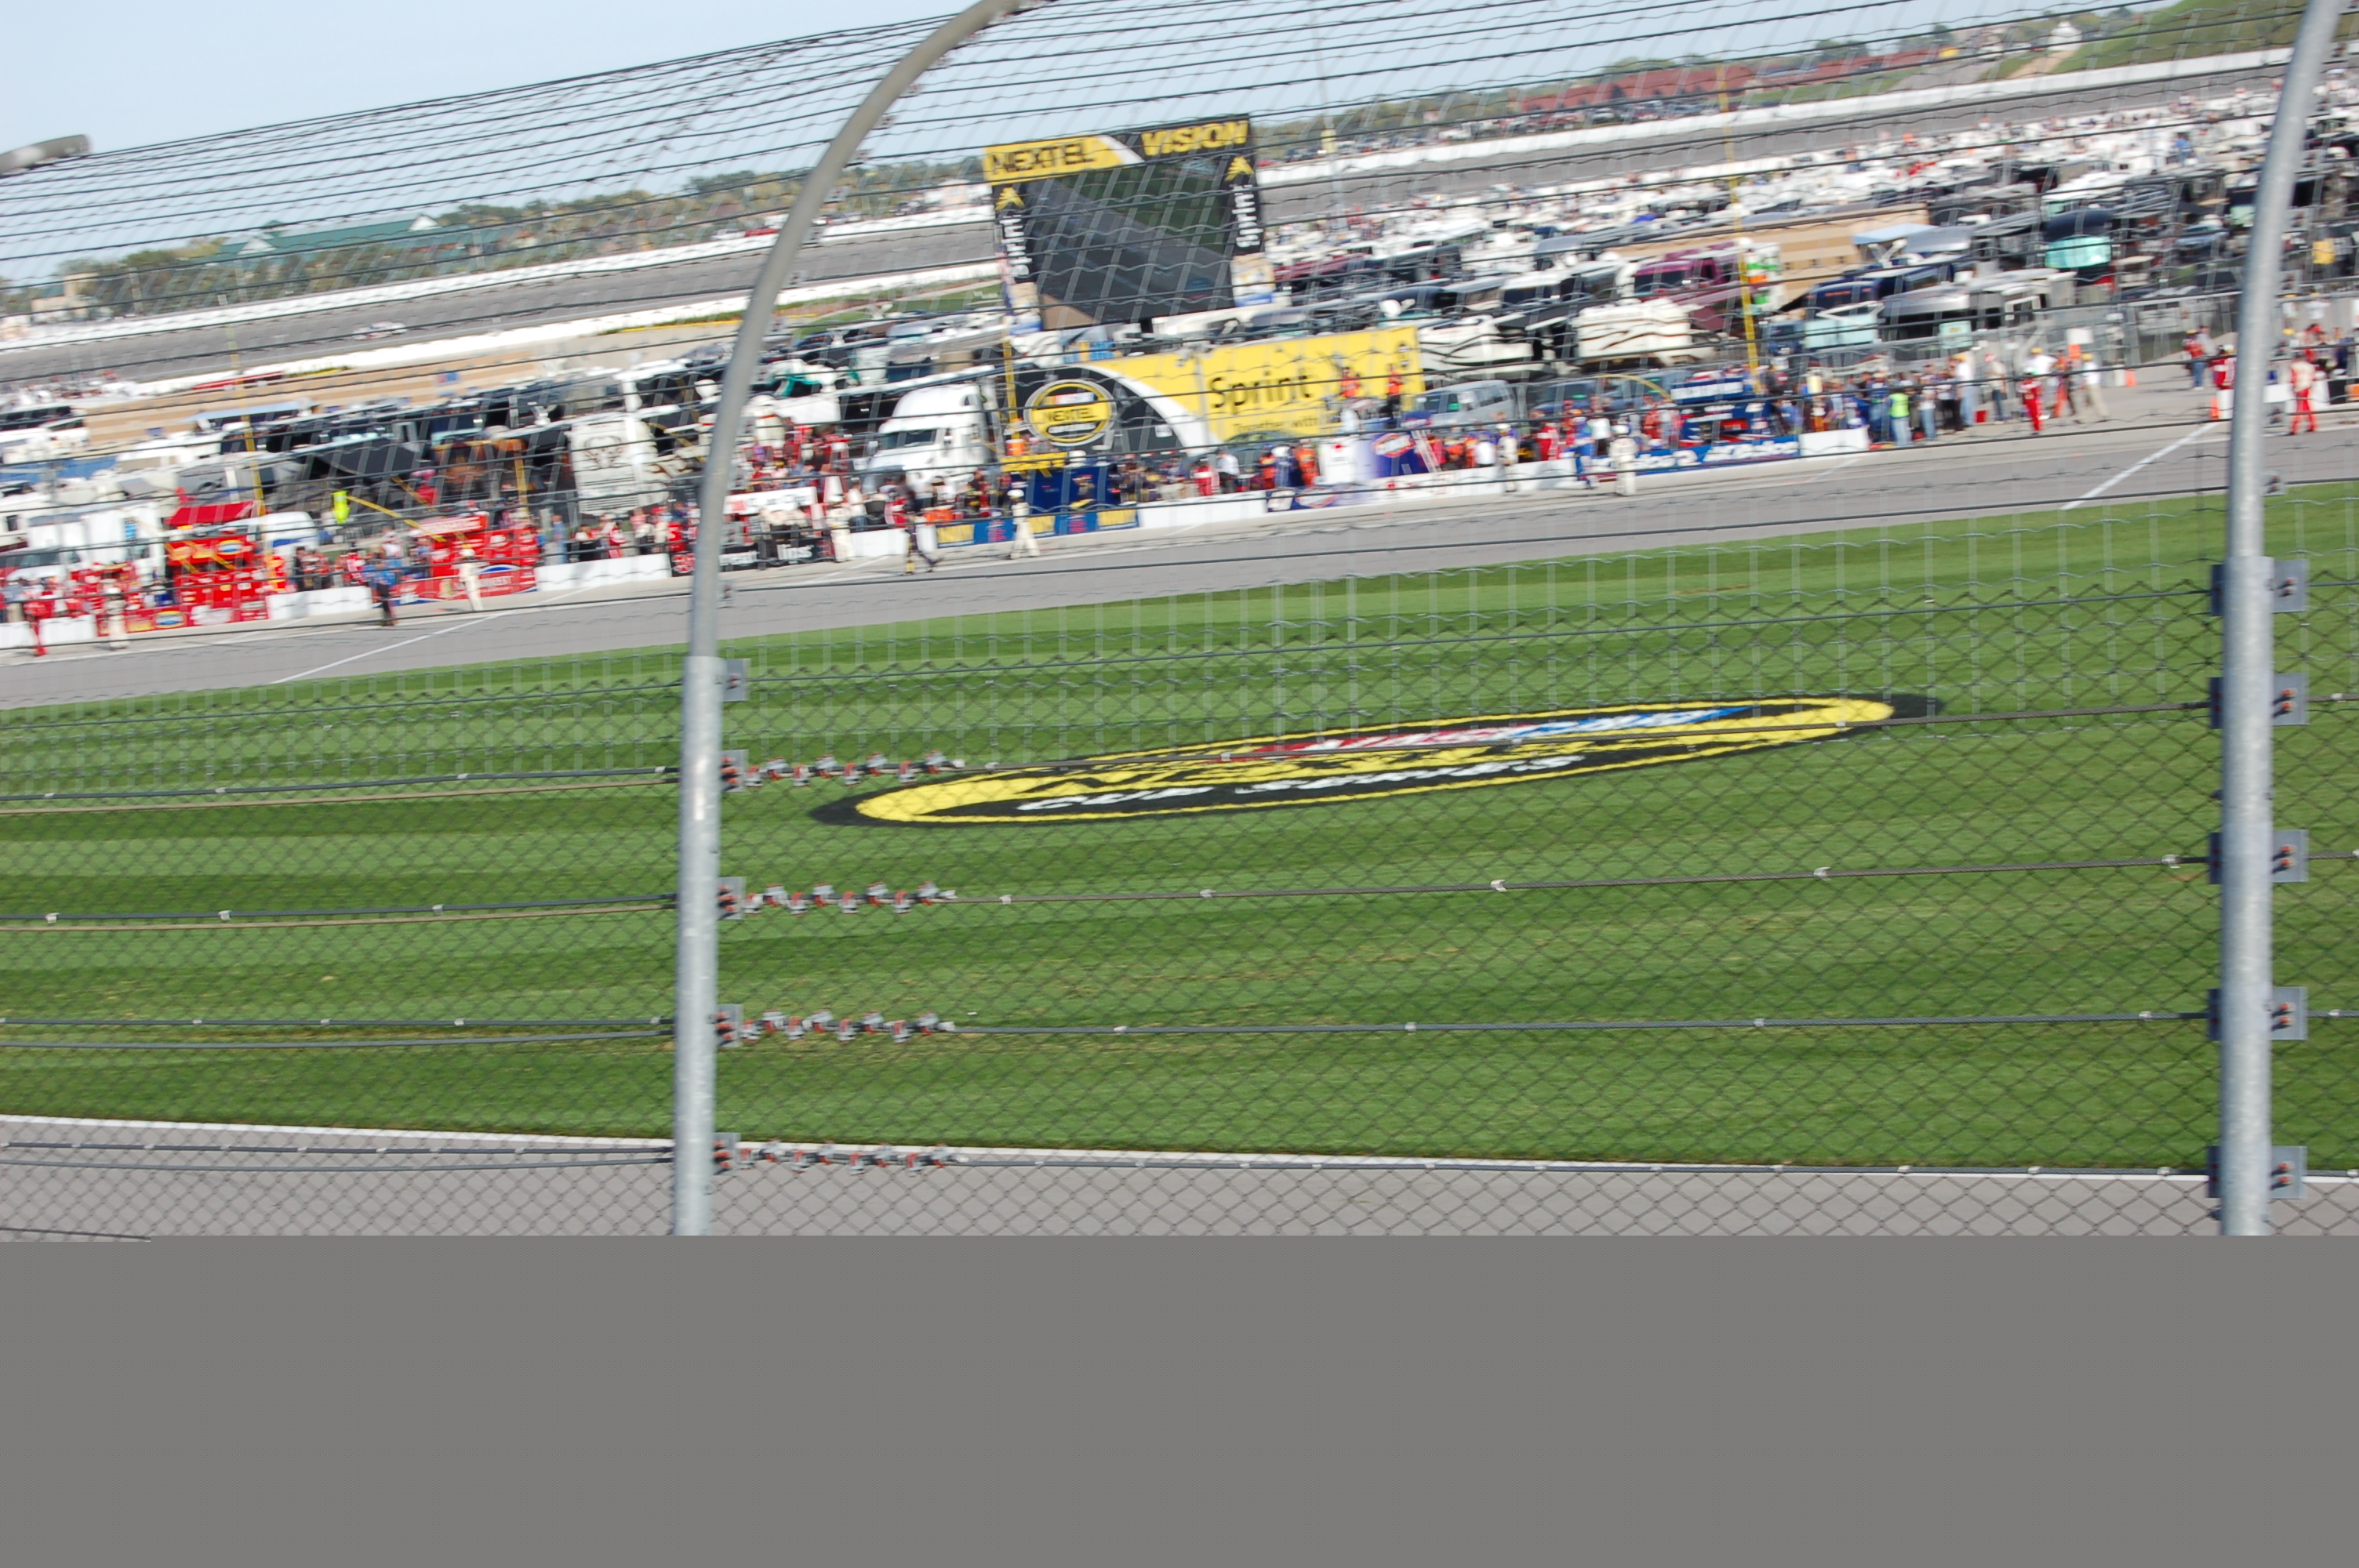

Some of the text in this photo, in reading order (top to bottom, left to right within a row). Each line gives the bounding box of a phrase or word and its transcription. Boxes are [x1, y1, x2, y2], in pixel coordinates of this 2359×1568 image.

[988, 119, 1249, 176] NEXTEL VISION
[1208, 366, 1311, 415] Sprint
[1016, 754, 1586, 811] CUP SERIES
[1020, 734, 1677, 793] NEXTEL
